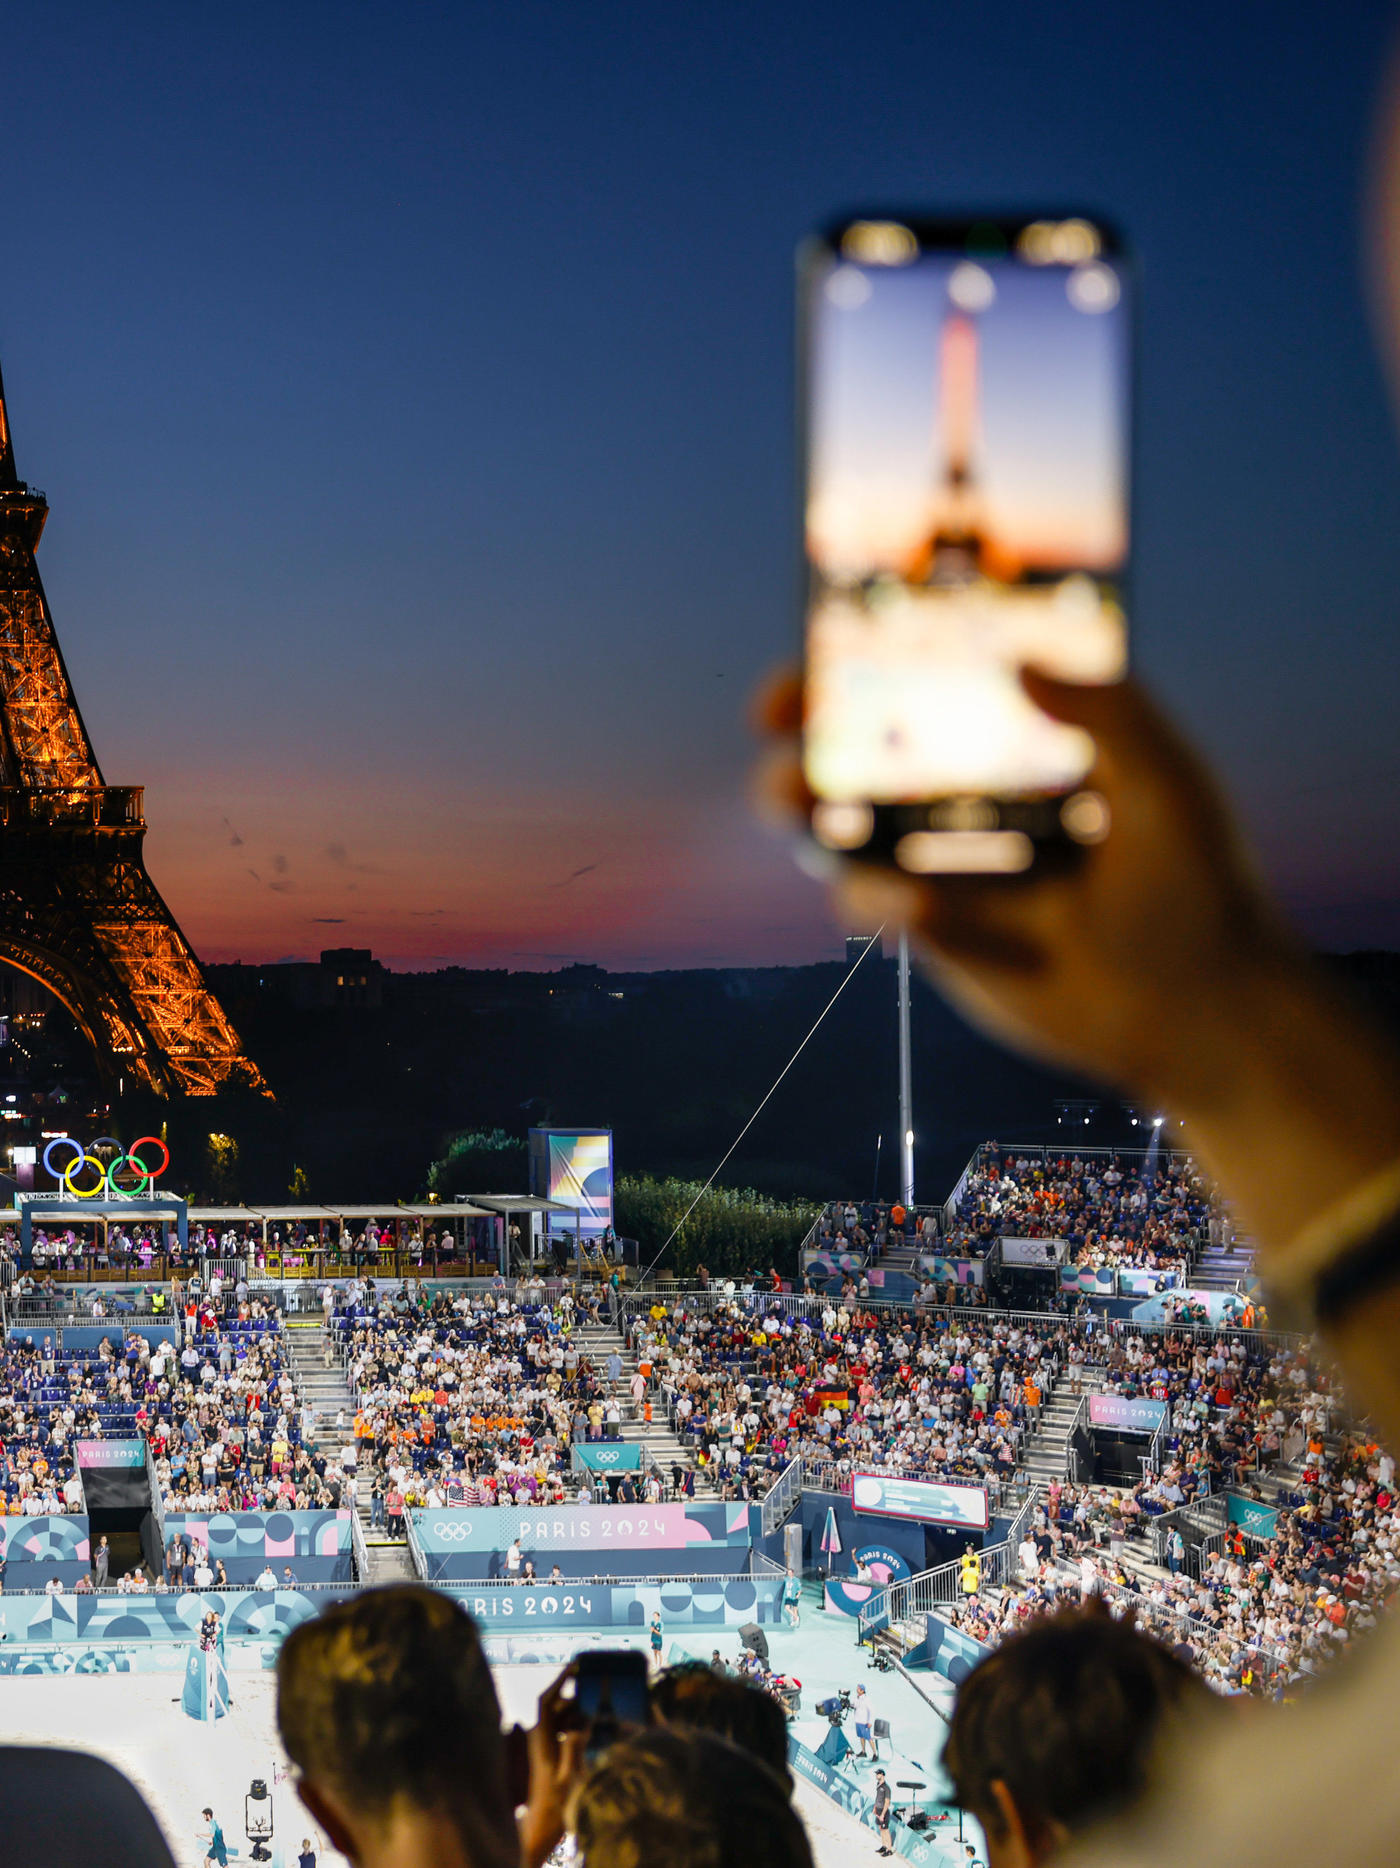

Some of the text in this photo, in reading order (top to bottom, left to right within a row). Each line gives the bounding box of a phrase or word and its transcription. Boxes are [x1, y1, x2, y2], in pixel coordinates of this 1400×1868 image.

[1095, 1405, 1161, 1419] PARIS 2024
[82, 1450, 140, 1459] PARIS 2024
[519, 1519, 665, 1538] PARIS 2024
[860, 1551, 901, 1569] PARIS 2024
[524, 1595, 592, 1616] 2024
